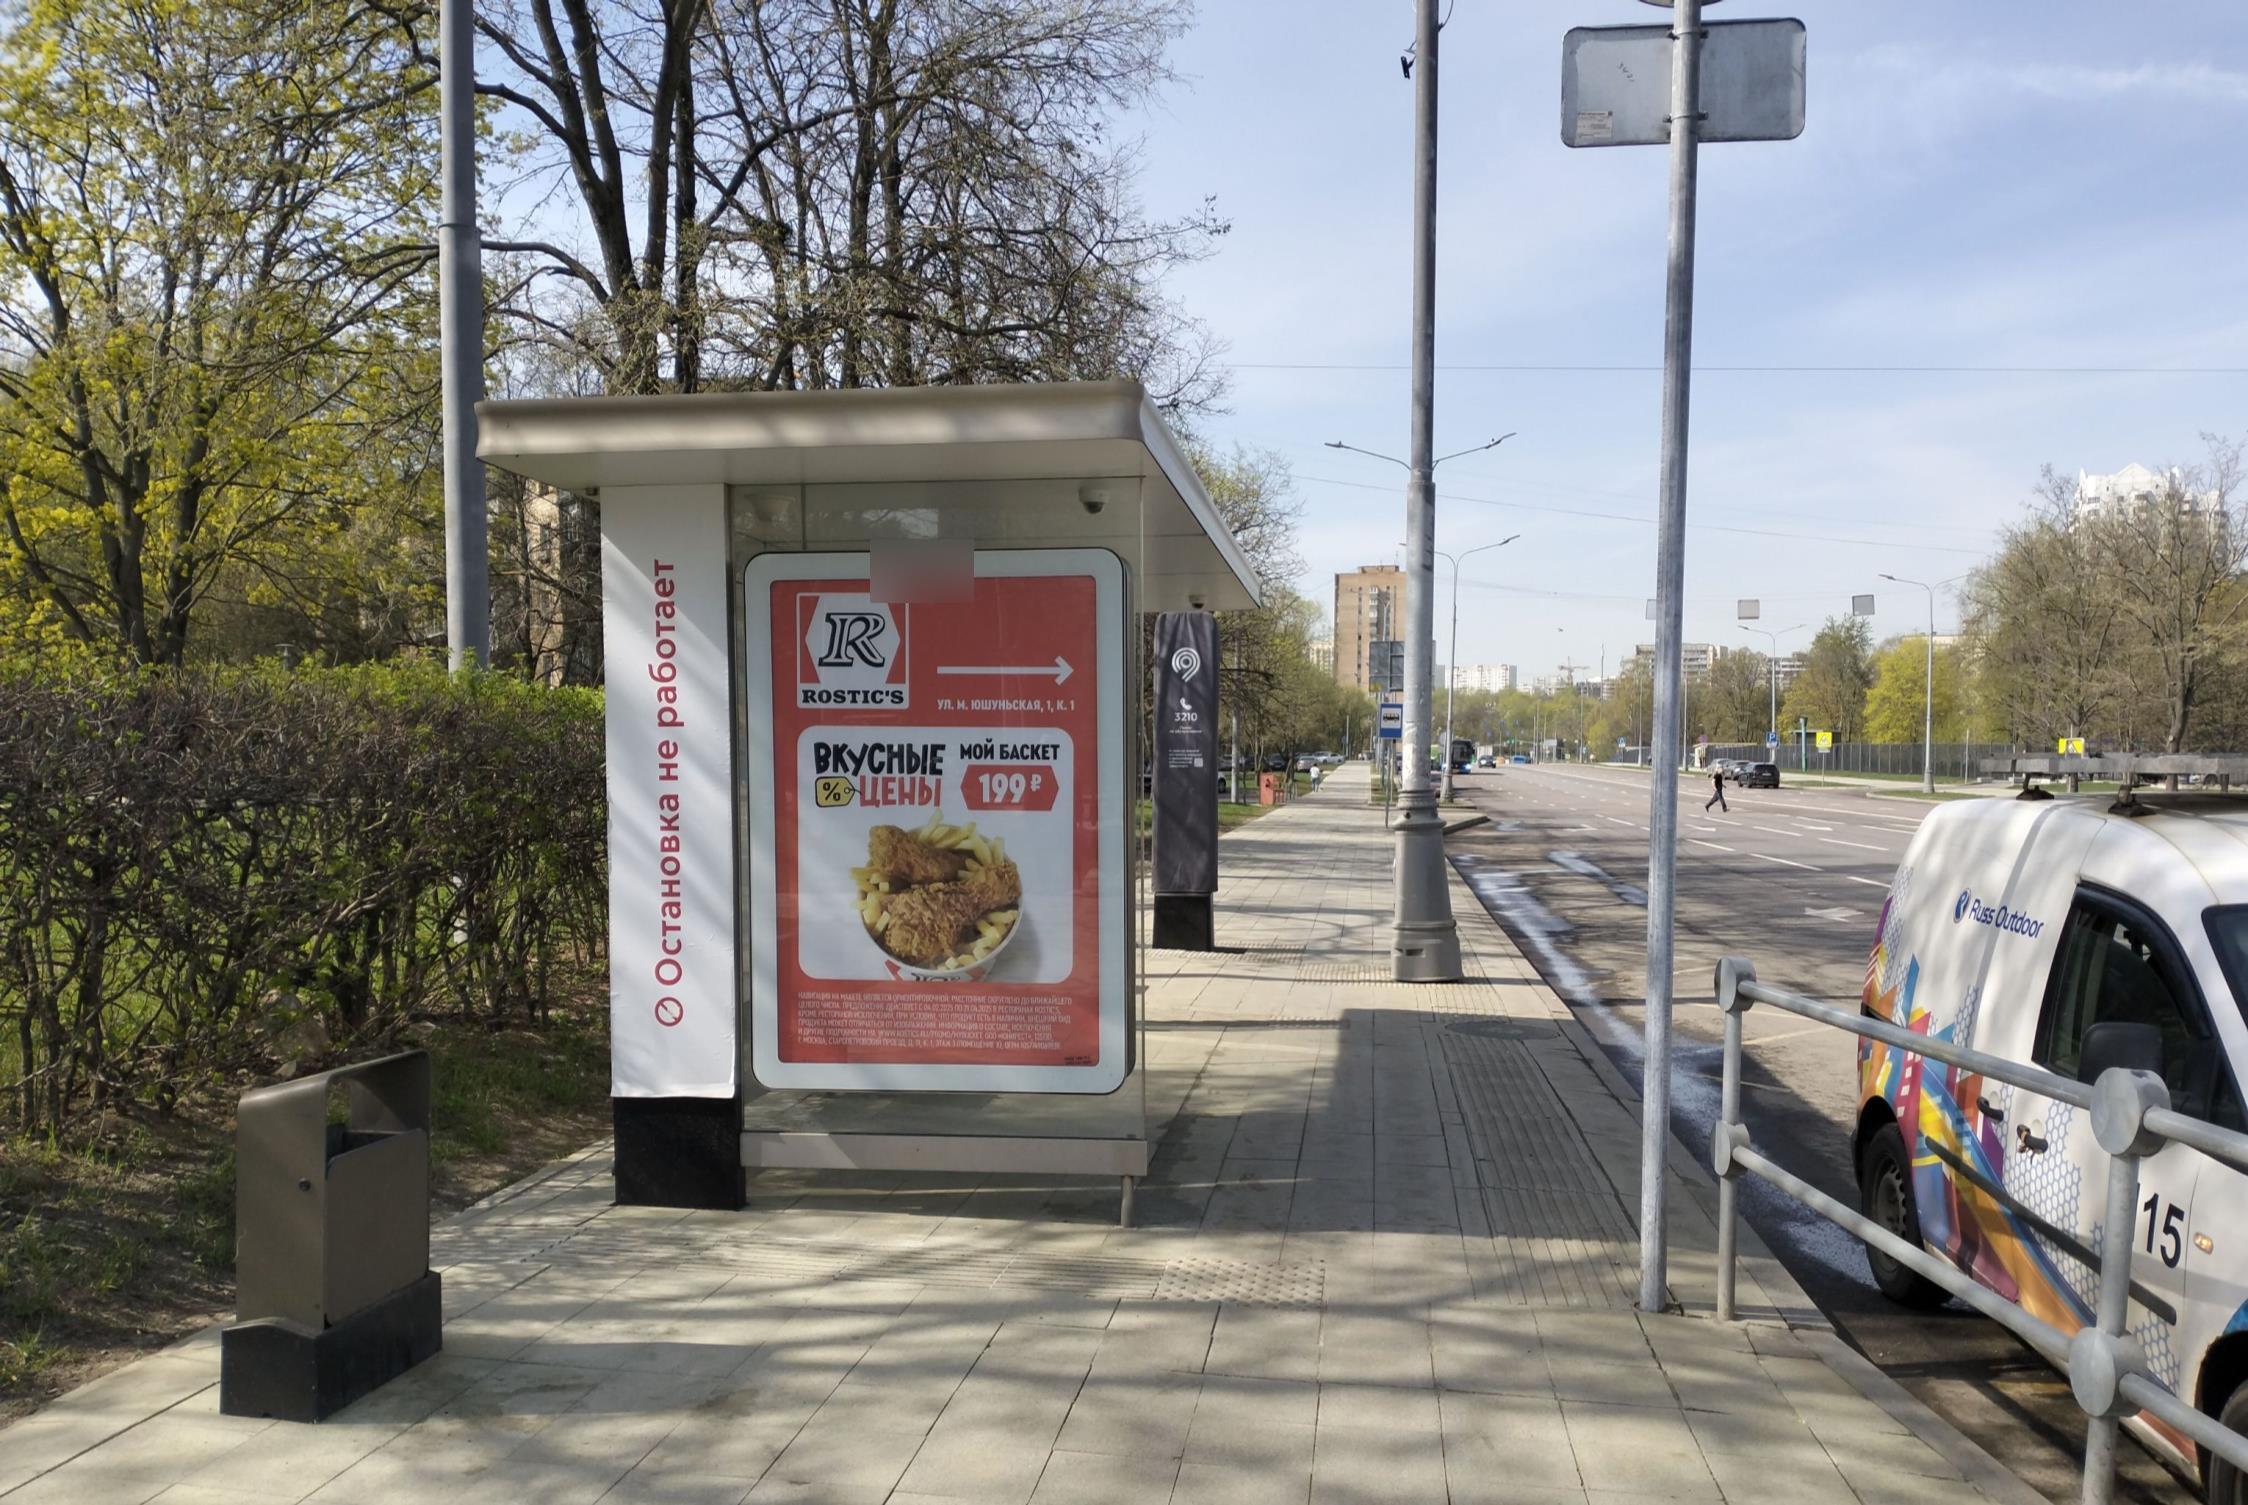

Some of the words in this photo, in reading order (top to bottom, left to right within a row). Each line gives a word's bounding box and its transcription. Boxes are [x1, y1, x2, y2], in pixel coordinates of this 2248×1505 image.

[648, 559, 684, 728] работает
[801, 689, 904, 704] ROSTIC'S
[937, 699, 954, 711] УЛ.
[971, 699, 1044, 713] ЮШУНЬСКАЯ,
[1046, 700, 1054, 713] 1,
[1056, 700, 1068, 711] К.
[1070, 700, 1075, 711] 1
[1174, 711, 1198, 722] 3210
[657, 739, 679, 782] не
[814, 742, 946, 777] ВКУСНЫЕ
[960, 738, 995, 760] МОЙ
[999, 744, 1060, 760] БАСКЕТ
[859, 775, 942, 808] ЦЕНЫ
[978, 773, 1026, 804] 199
[653, 792, 684, 986] Остановка
[1968, 898, 1996, 925] Russ
[1995, 905, 2044, 938] Outdoor
[2133, 1182, 2185, 1269] 15
